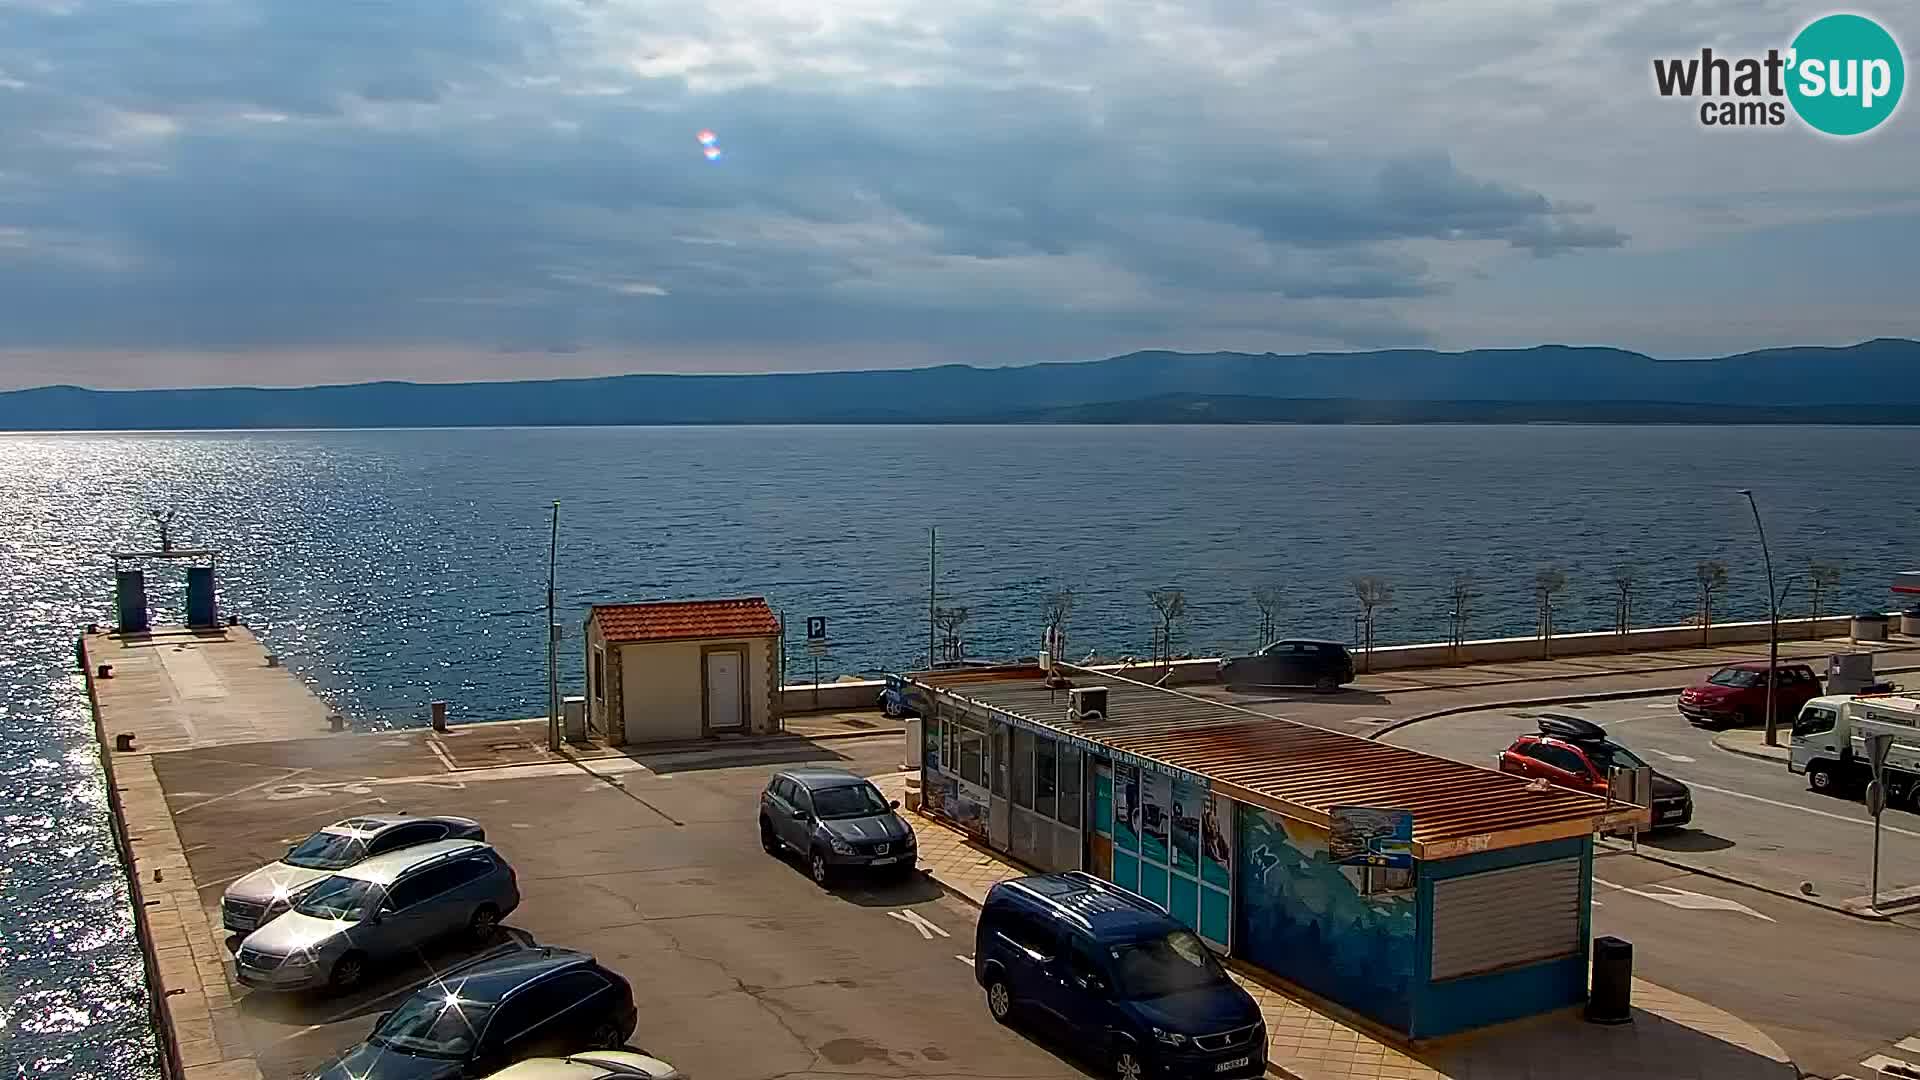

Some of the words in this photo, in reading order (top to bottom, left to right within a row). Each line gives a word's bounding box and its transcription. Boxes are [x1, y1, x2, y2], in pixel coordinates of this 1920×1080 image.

[811, 619, 822, 636] P
[1109, 748, 1122, 761] BUS
[1123, 753, 1155, 771] STATION
[1157, 763, 1181, 779] TICKET
